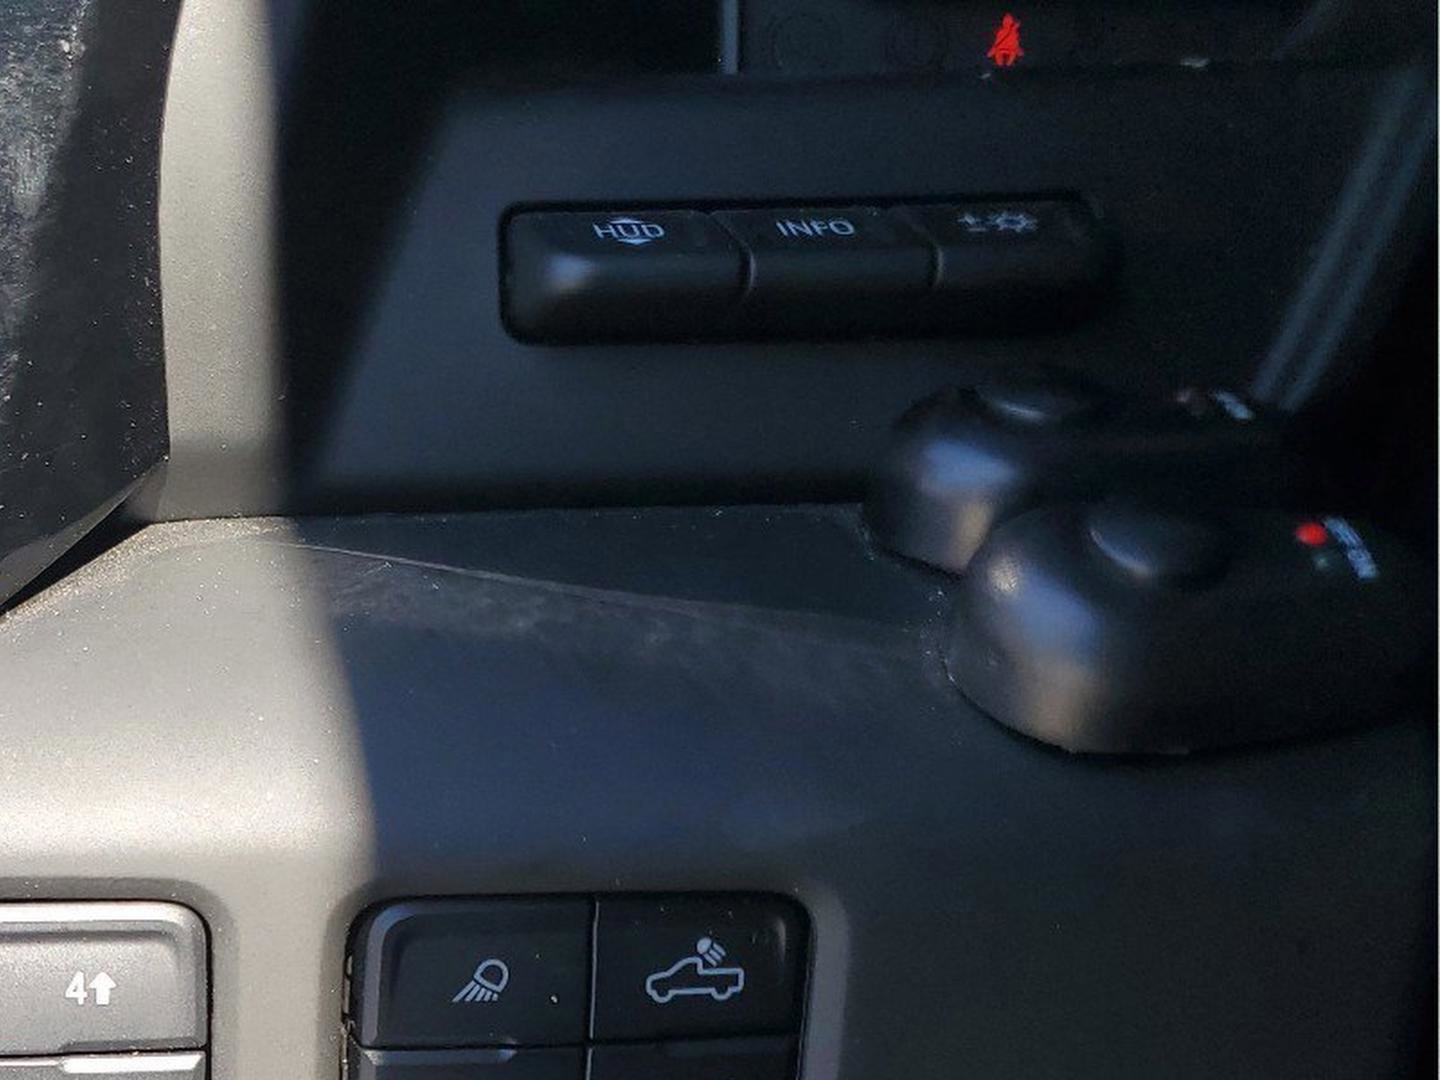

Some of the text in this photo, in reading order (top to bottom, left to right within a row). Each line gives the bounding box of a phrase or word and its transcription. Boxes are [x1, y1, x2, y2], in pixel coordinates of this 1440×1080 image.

[593, 220, 665, 240] HUD
[775, 219, 856, 238] INFO
[64, 971, 88, 1006] 4
